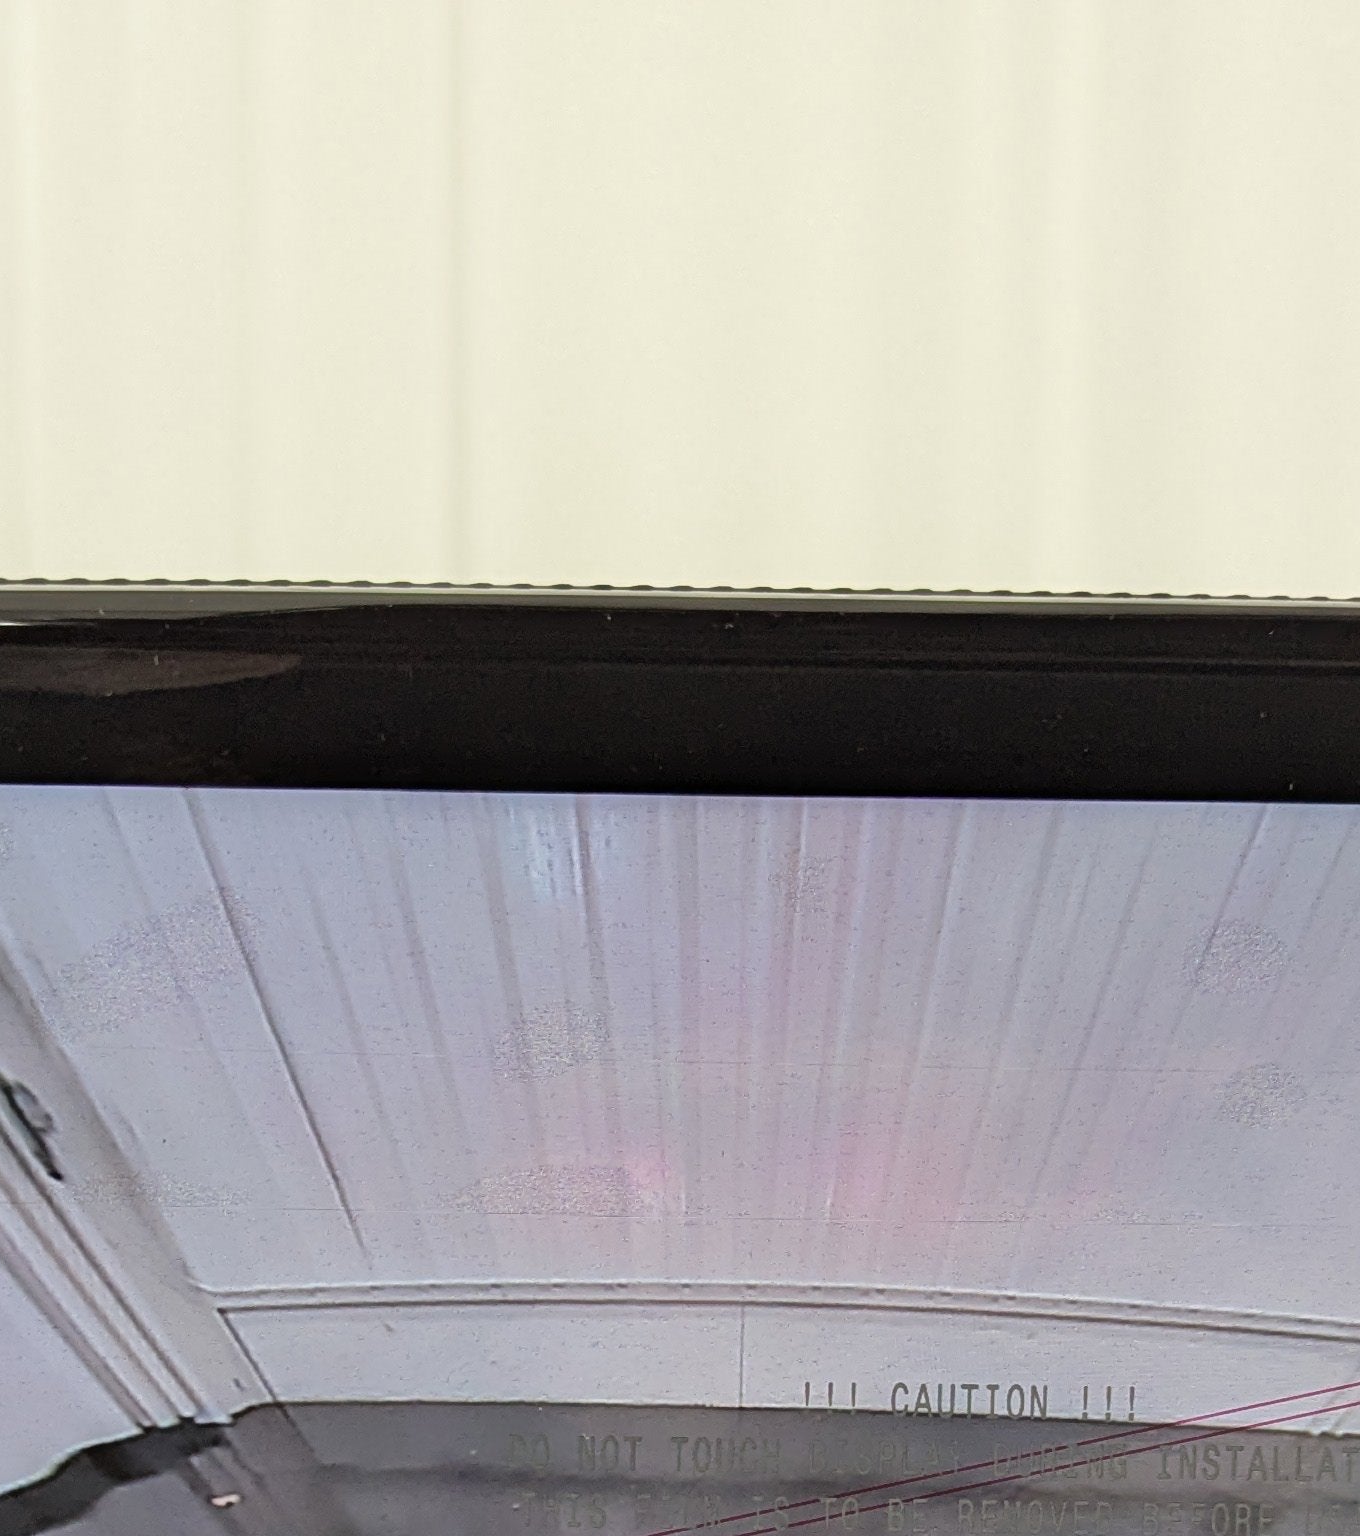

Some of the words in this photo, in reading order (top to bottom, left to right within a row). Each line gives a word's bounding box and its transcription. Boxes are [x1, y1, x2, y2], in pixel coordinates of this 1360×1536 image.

[889, 1381, 1049, 1420] CAUTION
[508, 1432, 552, 1470] DO
[577, 1434, 643, 1473] NOT
[671, 1435, 781, 1475] TOUCH
[808, 1437, 963, 1477] DISPLAY
[994, 1441, 1128, 1481] DURING
[522, 1491, 608, 1530] THIS
[751, 1495, 790, 1532] IS
[820, 1496, 859, 1532] TO
[886, 1498, 931, 1534] BE
[956, 1498, 1114, 1536] REMOVED
